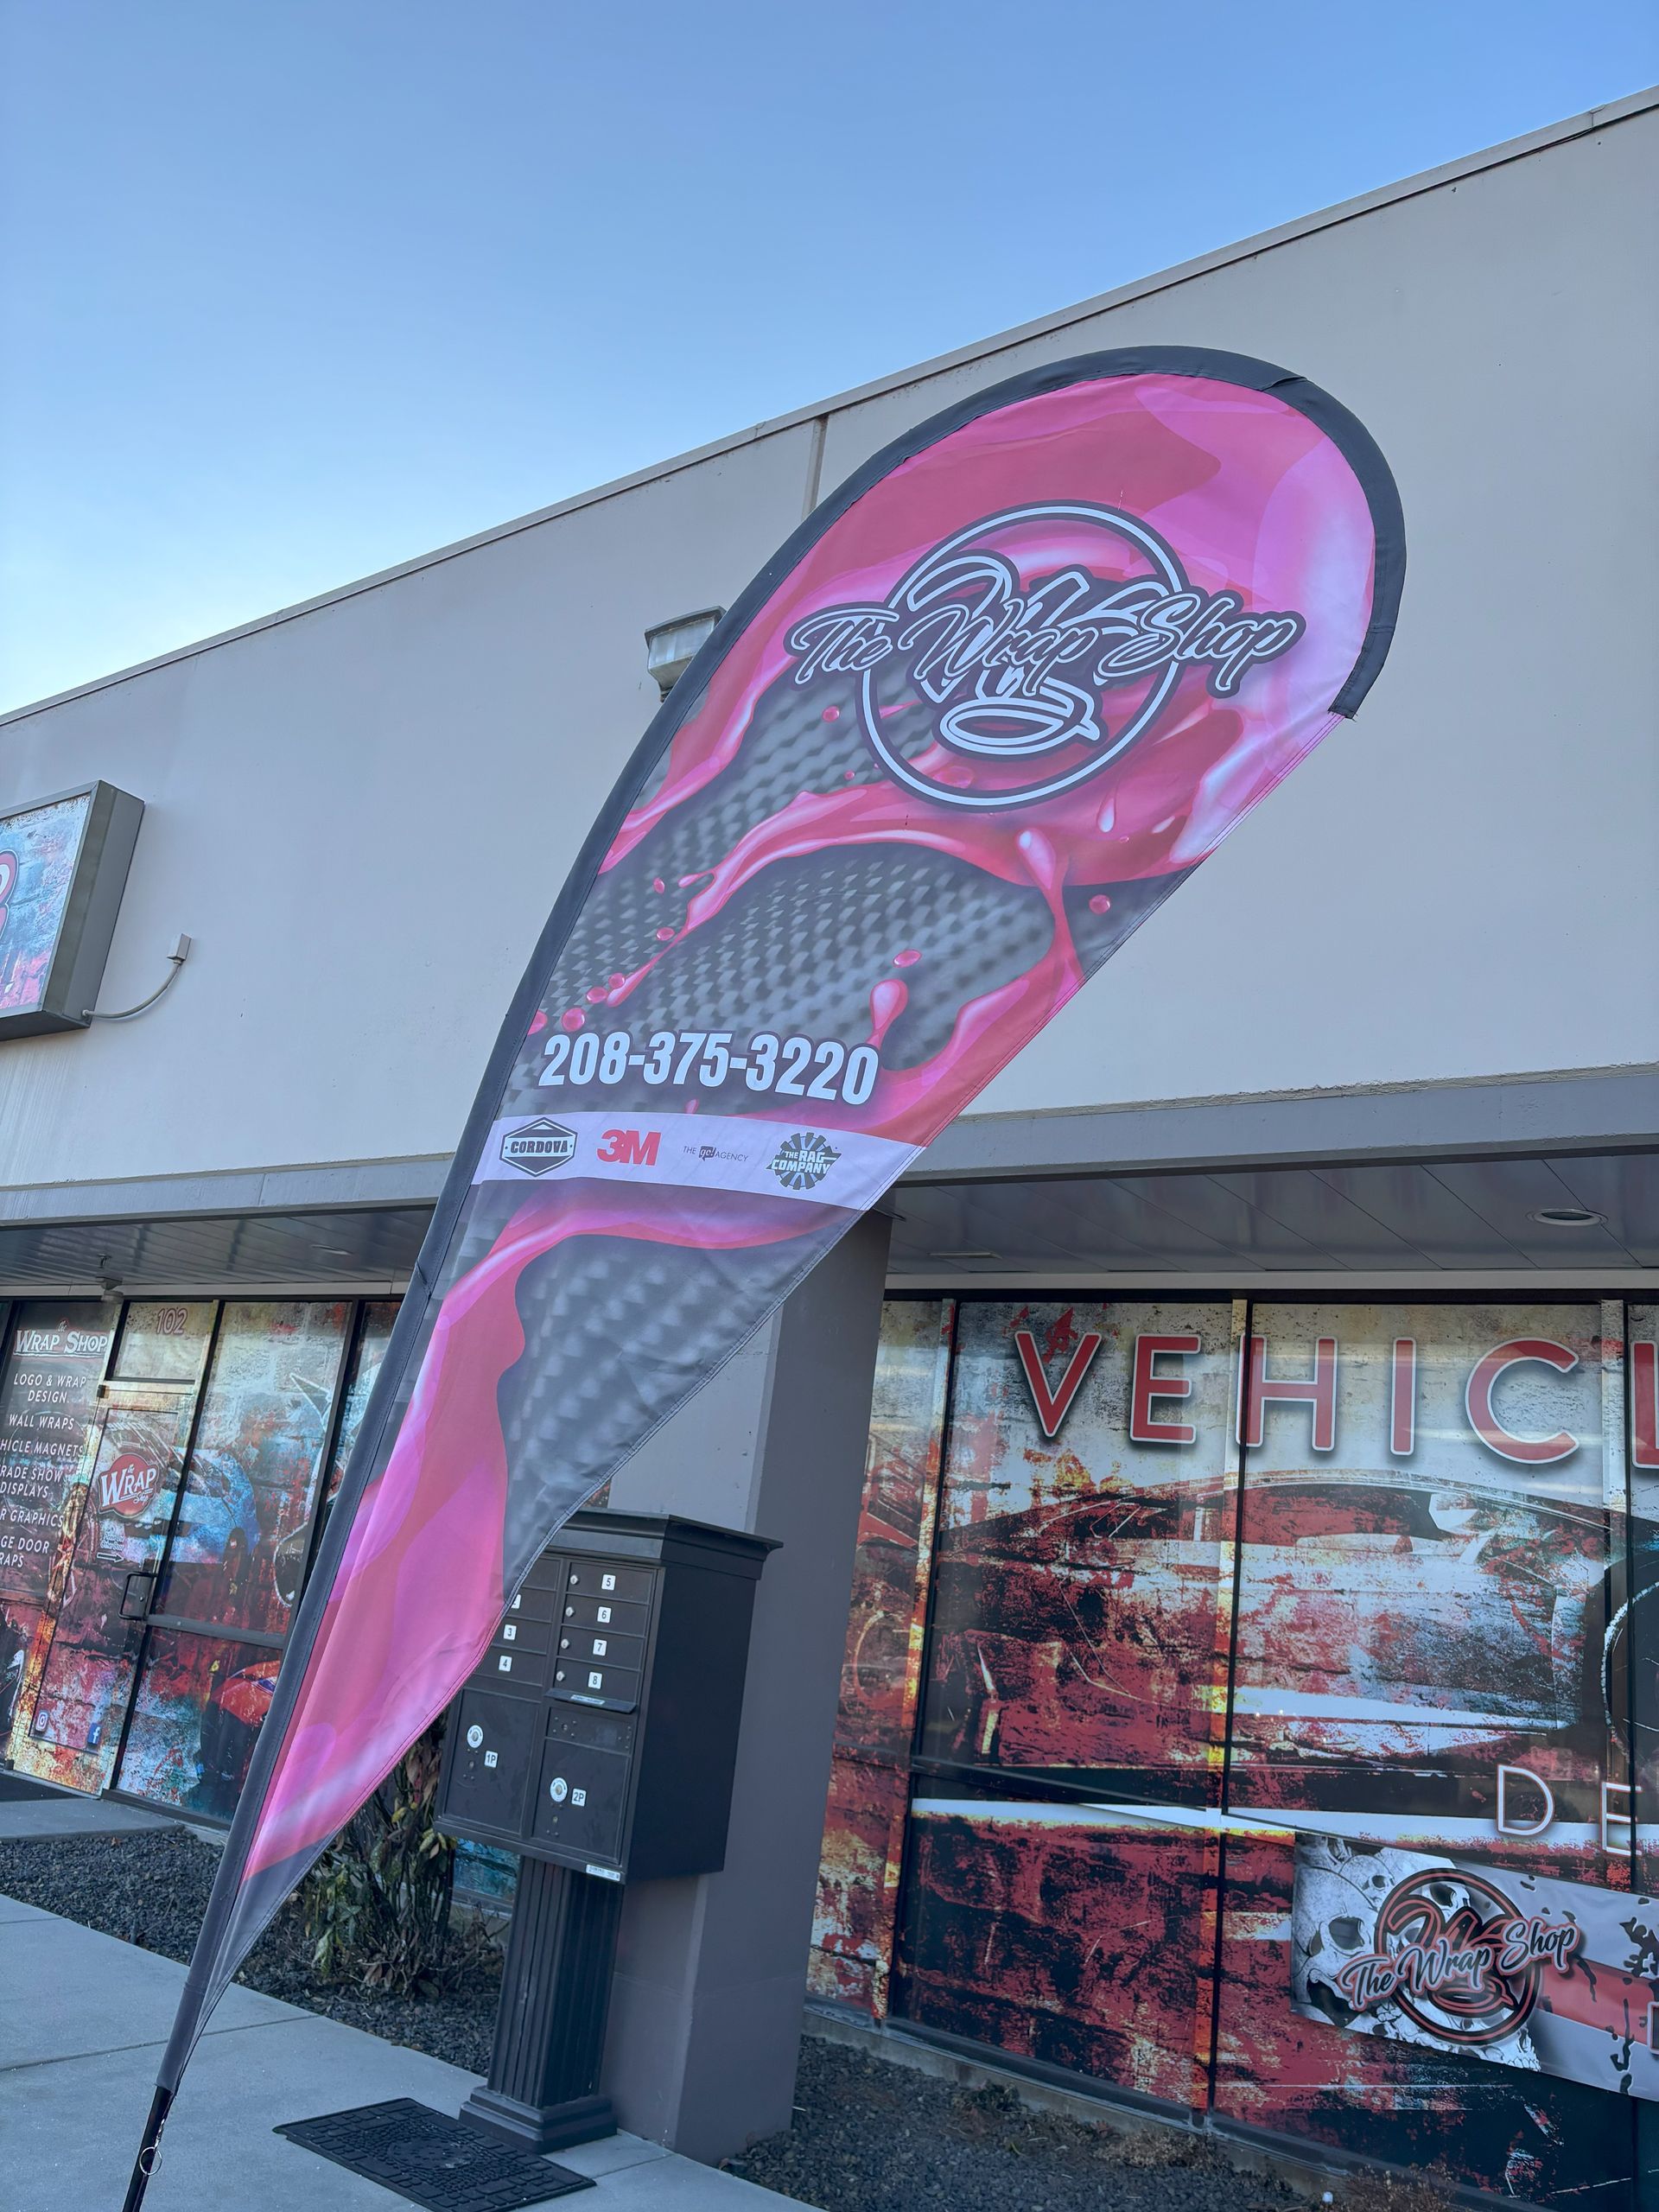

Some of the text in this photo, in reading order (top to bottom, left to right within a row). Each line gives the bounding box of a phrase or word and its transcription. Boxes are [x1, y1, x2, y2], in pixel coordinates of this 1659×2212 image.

[791, 593, 1298, 696] The Wrap Shop
[538, 1031, 880, 1106] 208-375-3220
[510, 1140, 569, 1154] CORDOVA
[596, 1128, 662, 1166] 3M
[683, 1146, 697, 1155] THE
[715, 1150, 749, 1162] AGENCY
[785, 1150, 836, 1163] THE RAG
[771, 1159, 831, 1174] COMPANY
[156, 1307, 188, 1335] 102
[16, 1330, 60, 1353] WRAP
[14, 1373, 86, 1388] LOGO & WRAP
[9, 1413, 75, 1430] WALL WRAPS
[0, 1438, 31, 1453] HICLE
[0, 1465, 63, 1484] RADE SHOW
[0, 1481, 49, 1498] DISPLAYS
[101, 1468, 156, 1507] WRAP
[10, 1510, 64, 1529] GRAPHICS
[17, 1537, 50, 1554] DOOR
[606, 1578, 612, 1587] 5
[601, 1610, 607, 1619] 6
[507, 1627, 512, 1637] 3
[597, 1643, 603, 1652] 7
[502, 1659, 508, 1668] 4
[592, 1675, 598, 1685] 8
[486, 1754, 496, 1764] 1P
[573, 1792, 584, 1802] 2P
[1341, 1916, 1580, 2011] The Wrap Shop
